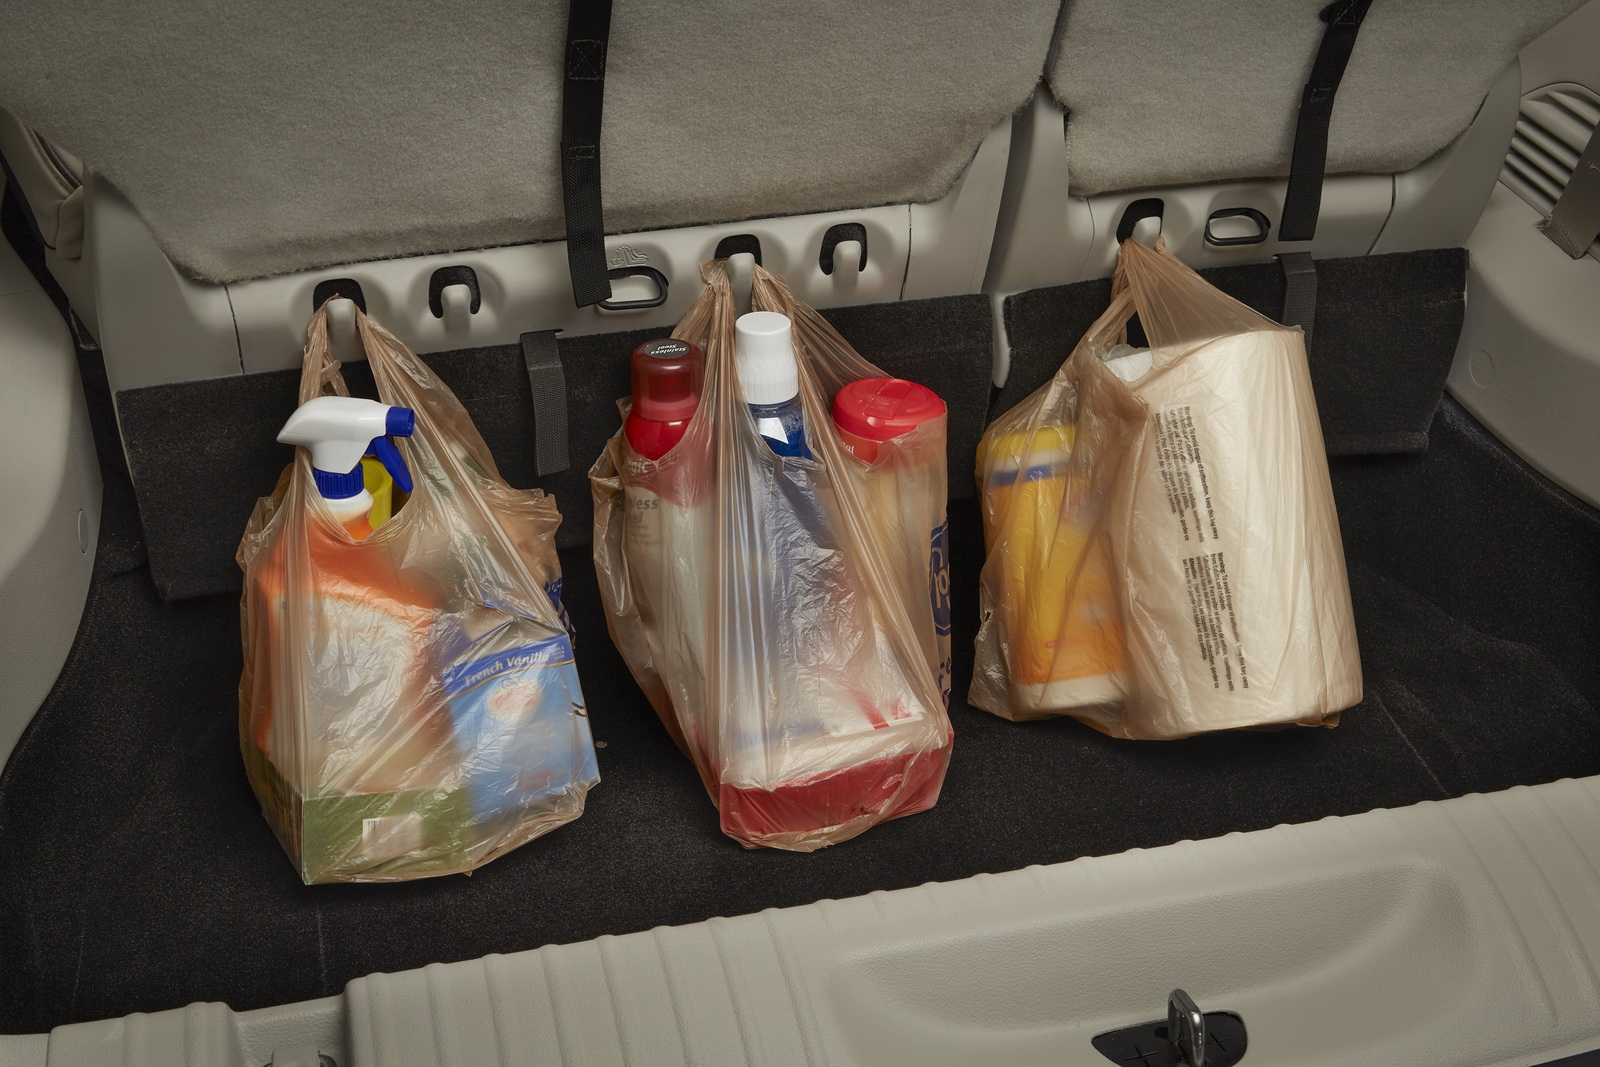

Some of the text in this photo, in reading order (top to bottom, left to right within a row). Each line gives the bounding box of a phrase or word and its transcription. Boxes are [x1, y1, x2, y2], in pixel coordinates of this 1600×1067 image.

[1199, 469, 1208, 496] suffocation,
[1180, 519, 1188, 534] garder
[466, 661, 504, 687] French
[507, 651, 549, 668] Vanilla
[1206, 639, 1214, 666] suffocation,
[1210, 667, 1218, 682] garder
